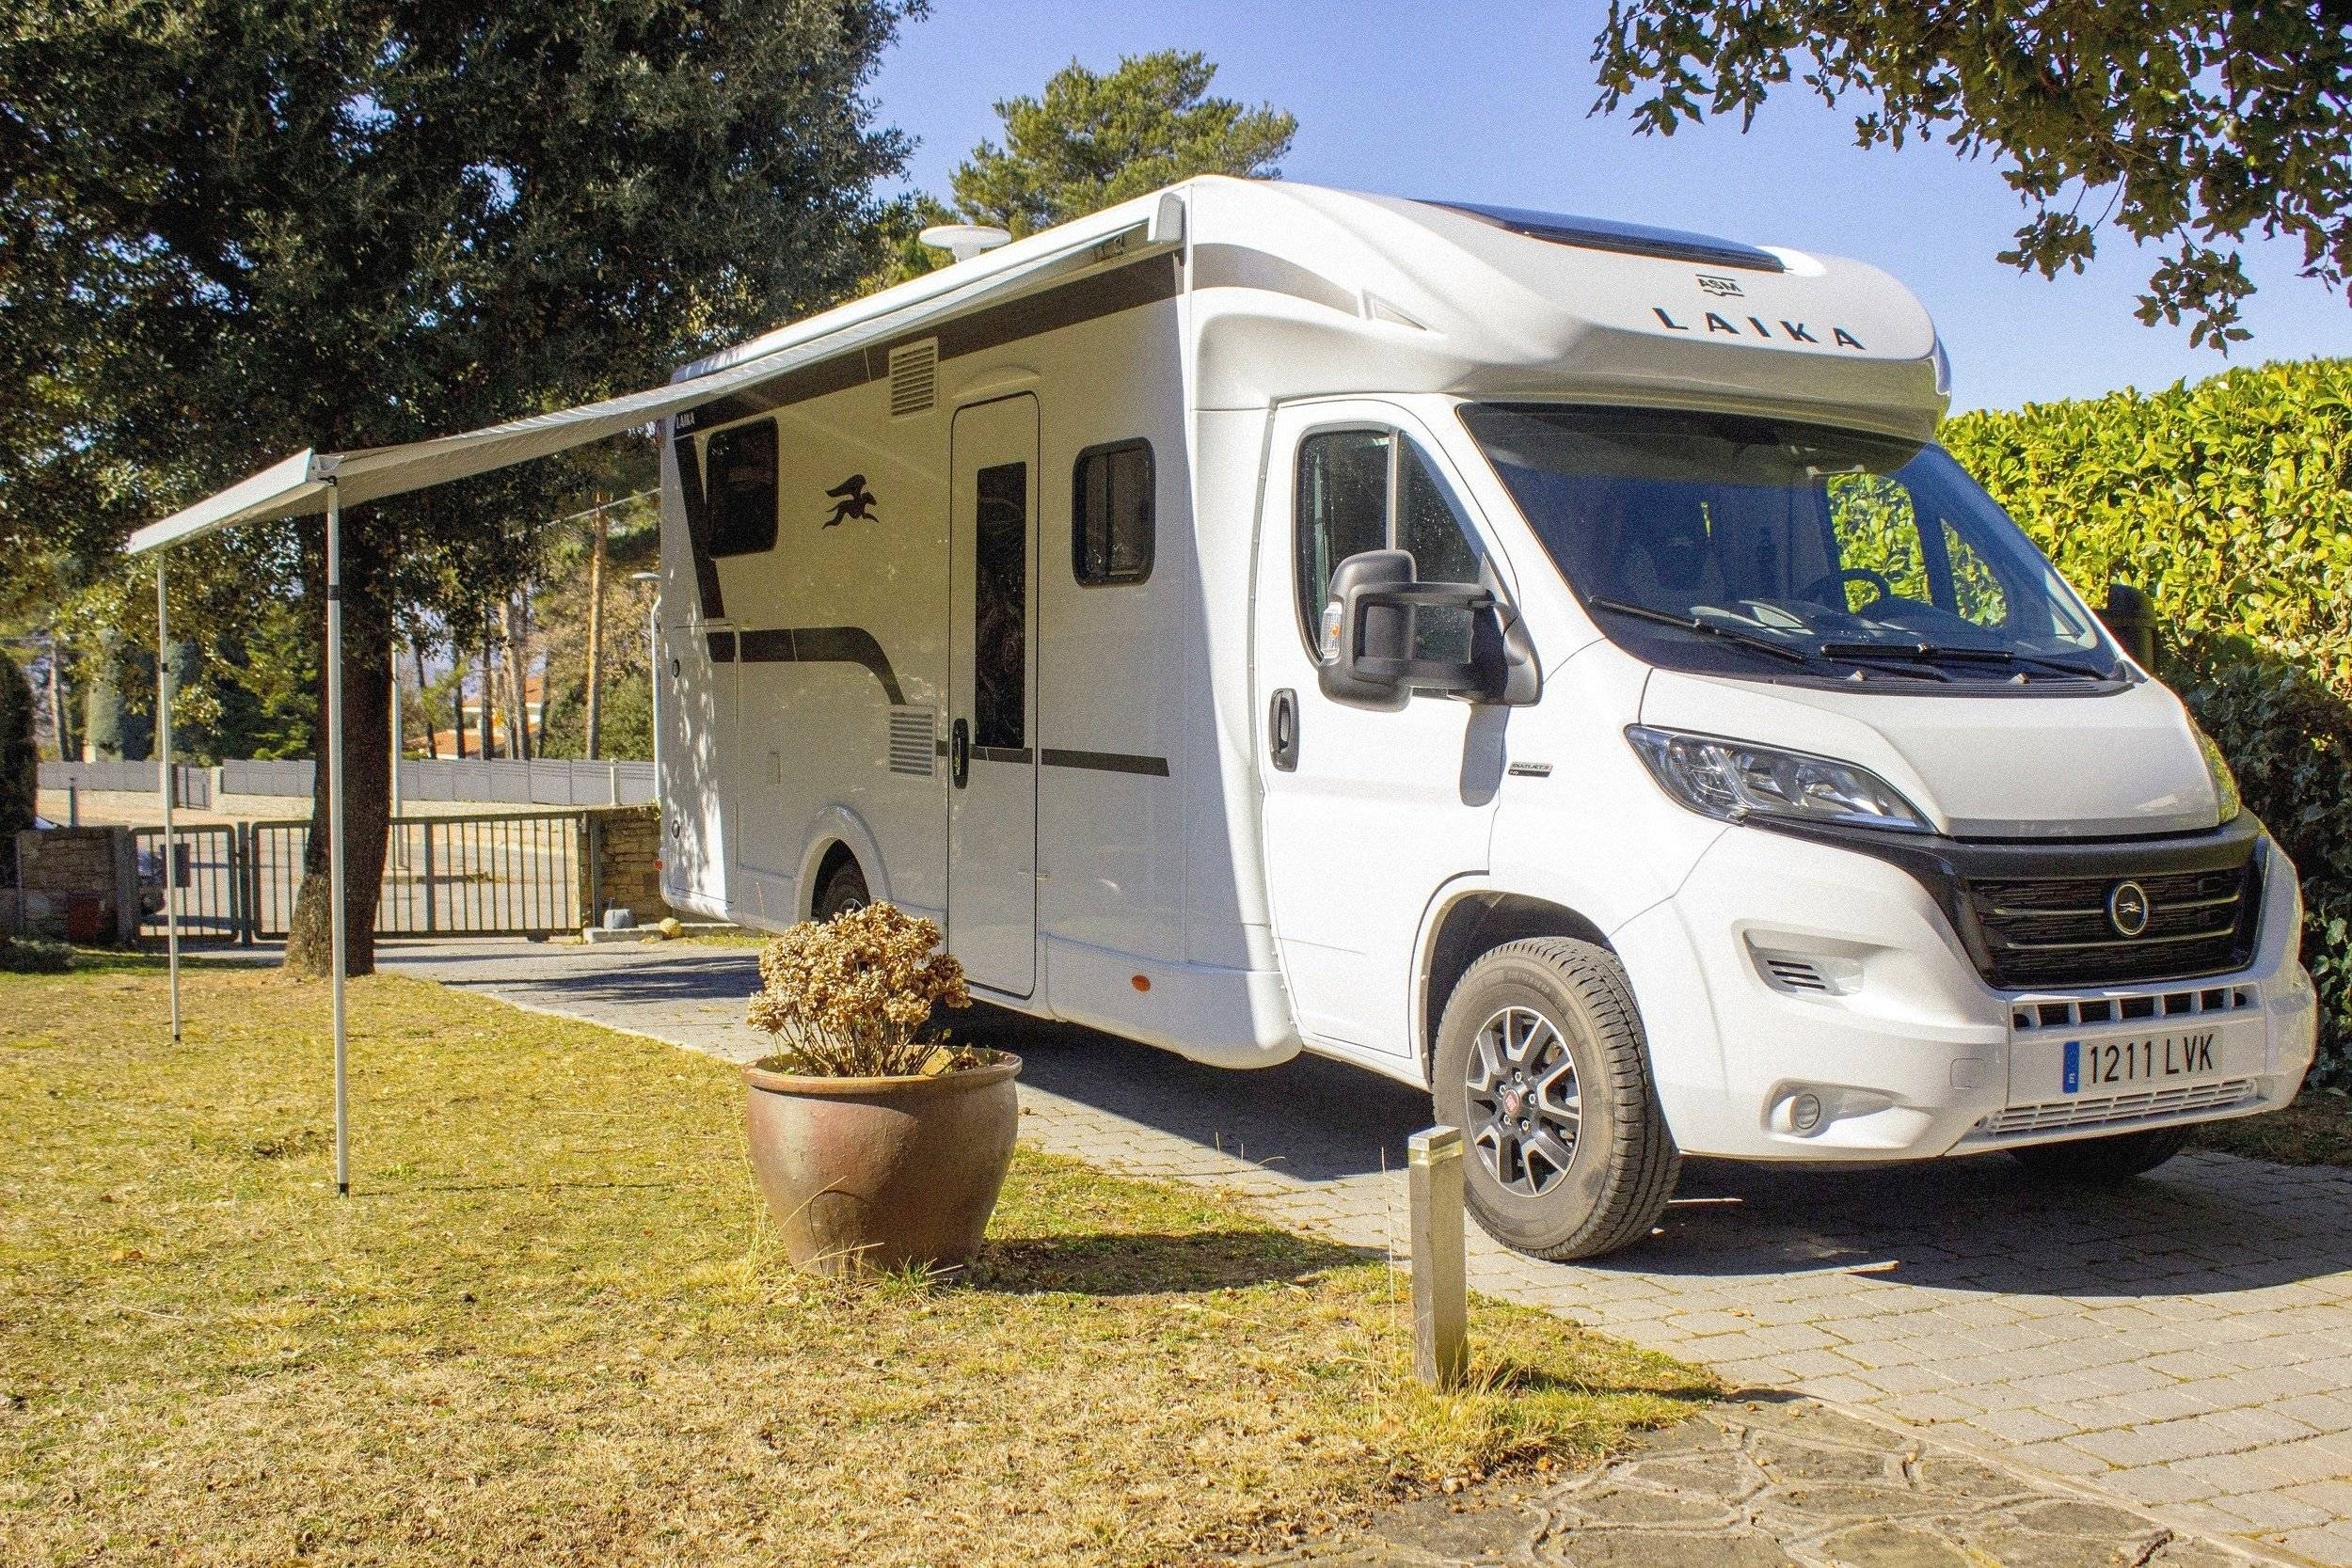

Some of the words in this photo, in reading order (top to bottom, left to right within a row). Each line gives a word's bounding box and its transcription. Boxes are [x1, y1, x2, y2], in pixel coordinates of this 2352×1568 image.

[1652, 308, 1866, 350] LAIKA
[2090, 1041, 2152, 1084] 1211
[2166, 1034, 2213, 1075] LVK
